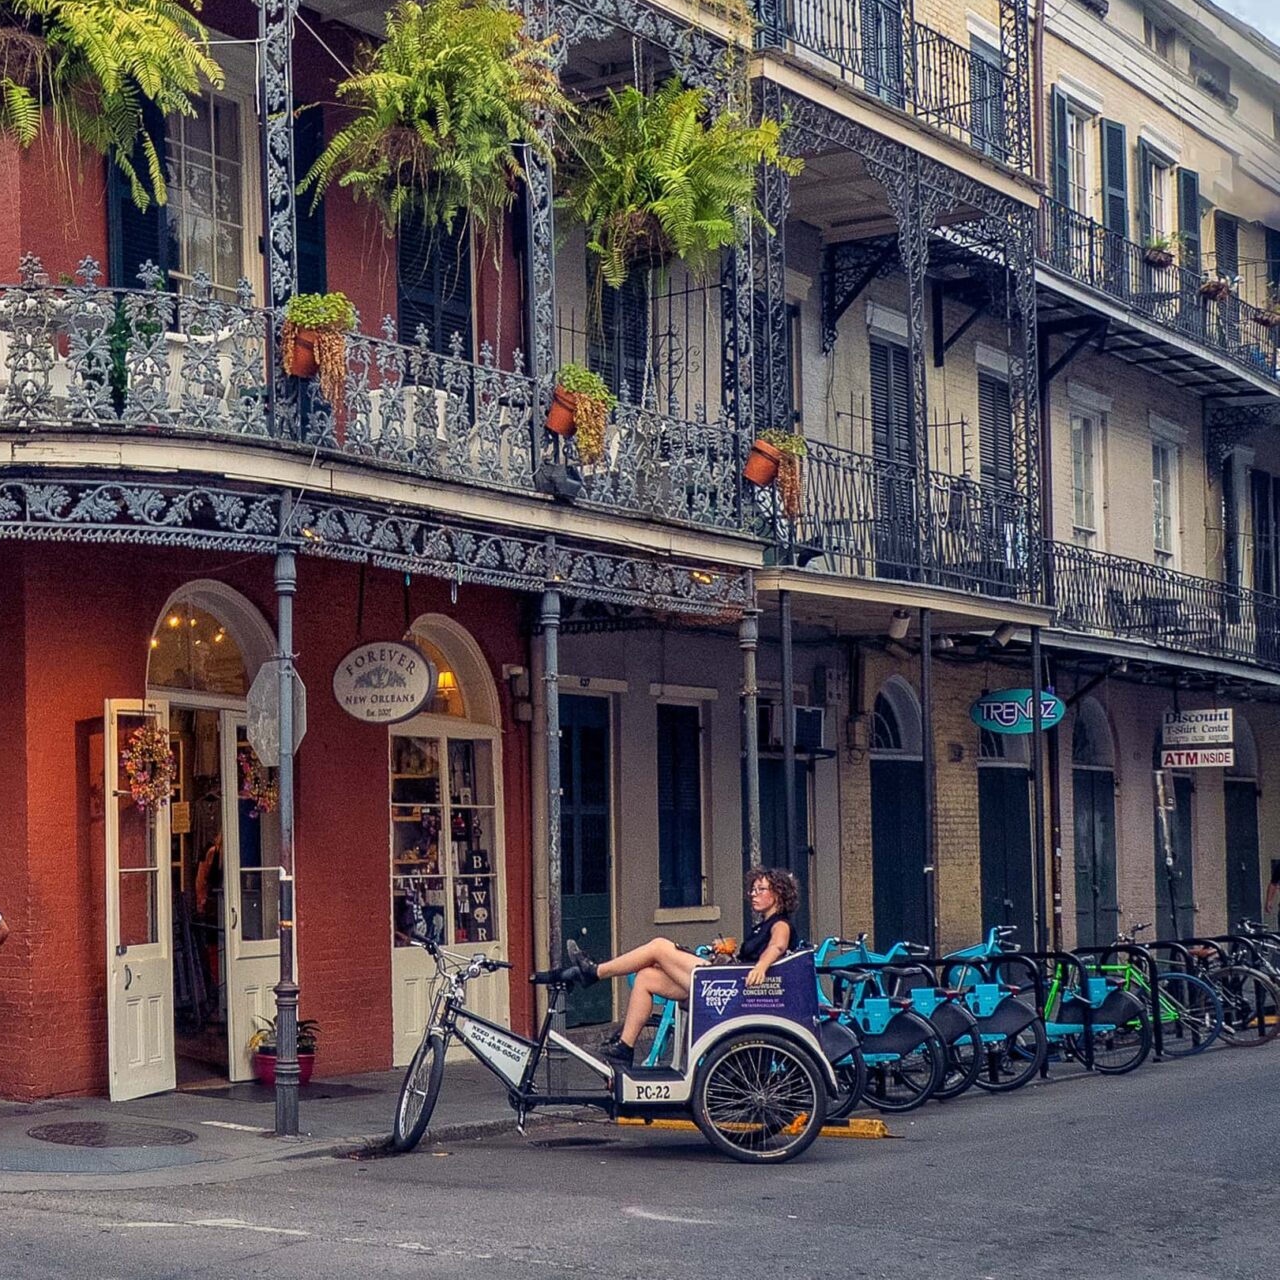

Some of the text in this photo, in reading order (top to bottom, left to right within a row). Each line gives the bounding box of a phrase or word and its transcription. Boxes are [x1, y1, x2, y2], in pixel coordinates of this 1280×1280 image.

[346, 649, 415, 676] FOREVER
[345, 694, 415, 705] NEW ORLEANS
[1165, 710, 1230, 724] Discount
[1164, 751, 1231, 766] ATM INSIDE
[701, 980, 739, 997] Vintage
[472, 1025, 490, 1038] NEED
[636, 1085, 670, 1100] PC-22
